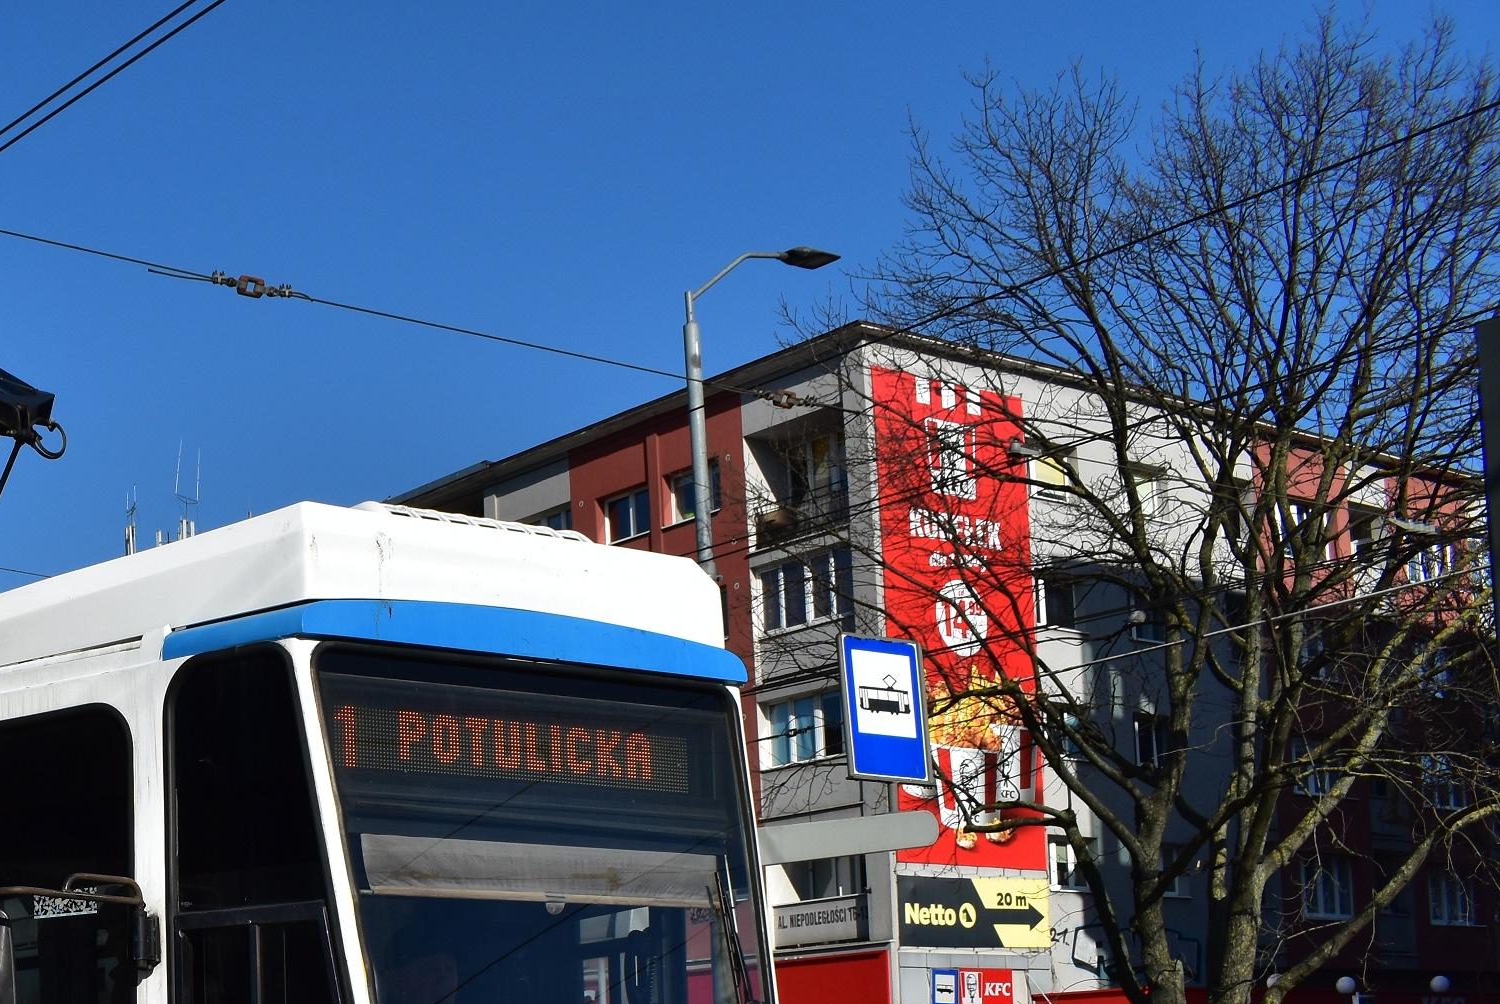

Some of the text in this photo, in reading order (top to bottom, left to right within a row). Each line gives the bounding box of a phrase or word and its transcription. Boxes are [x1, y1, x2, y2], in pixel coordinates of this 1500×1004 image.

[335, 705, 652, 780] 1 POTULICKA
[996, 892, 1027, 907] 20 m
[778, 916, 788, 929] AL.
[789, 906, 847, 929] NIEPODLEGŁOŚCI
[904, 902, 956, 925] Netto
[984, 981, 1012, 997] KFC
